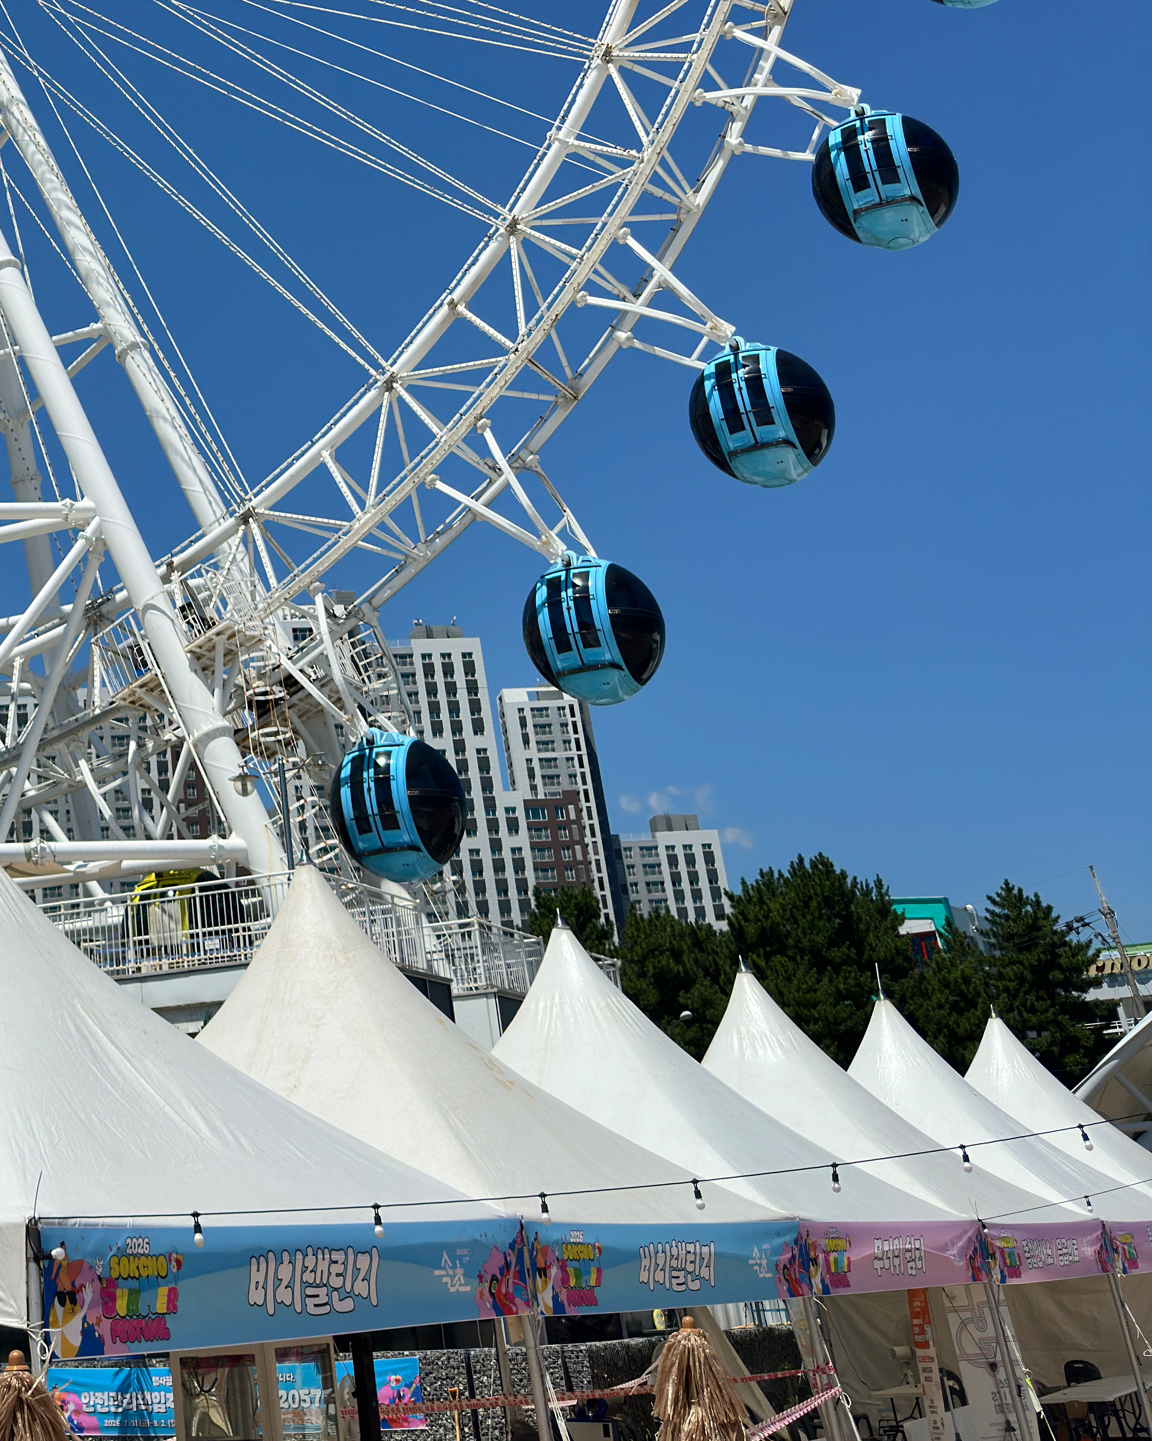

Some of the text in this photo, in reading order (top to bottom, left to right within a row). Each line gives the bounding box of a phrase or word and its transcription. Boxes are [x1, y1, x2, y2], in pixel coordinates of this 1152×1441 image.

[109, 1254, 168, 1280] SOKCHO
[125, 1236, 150, 1255] 2026
[639, 1238, 716, 1292] 비치챌린지
[873, 1235, 904, 1277] 무더위
[905, 1234, 926, 1276] 쉼터
[248, 1245, 380, 1316] 비치챌린지
